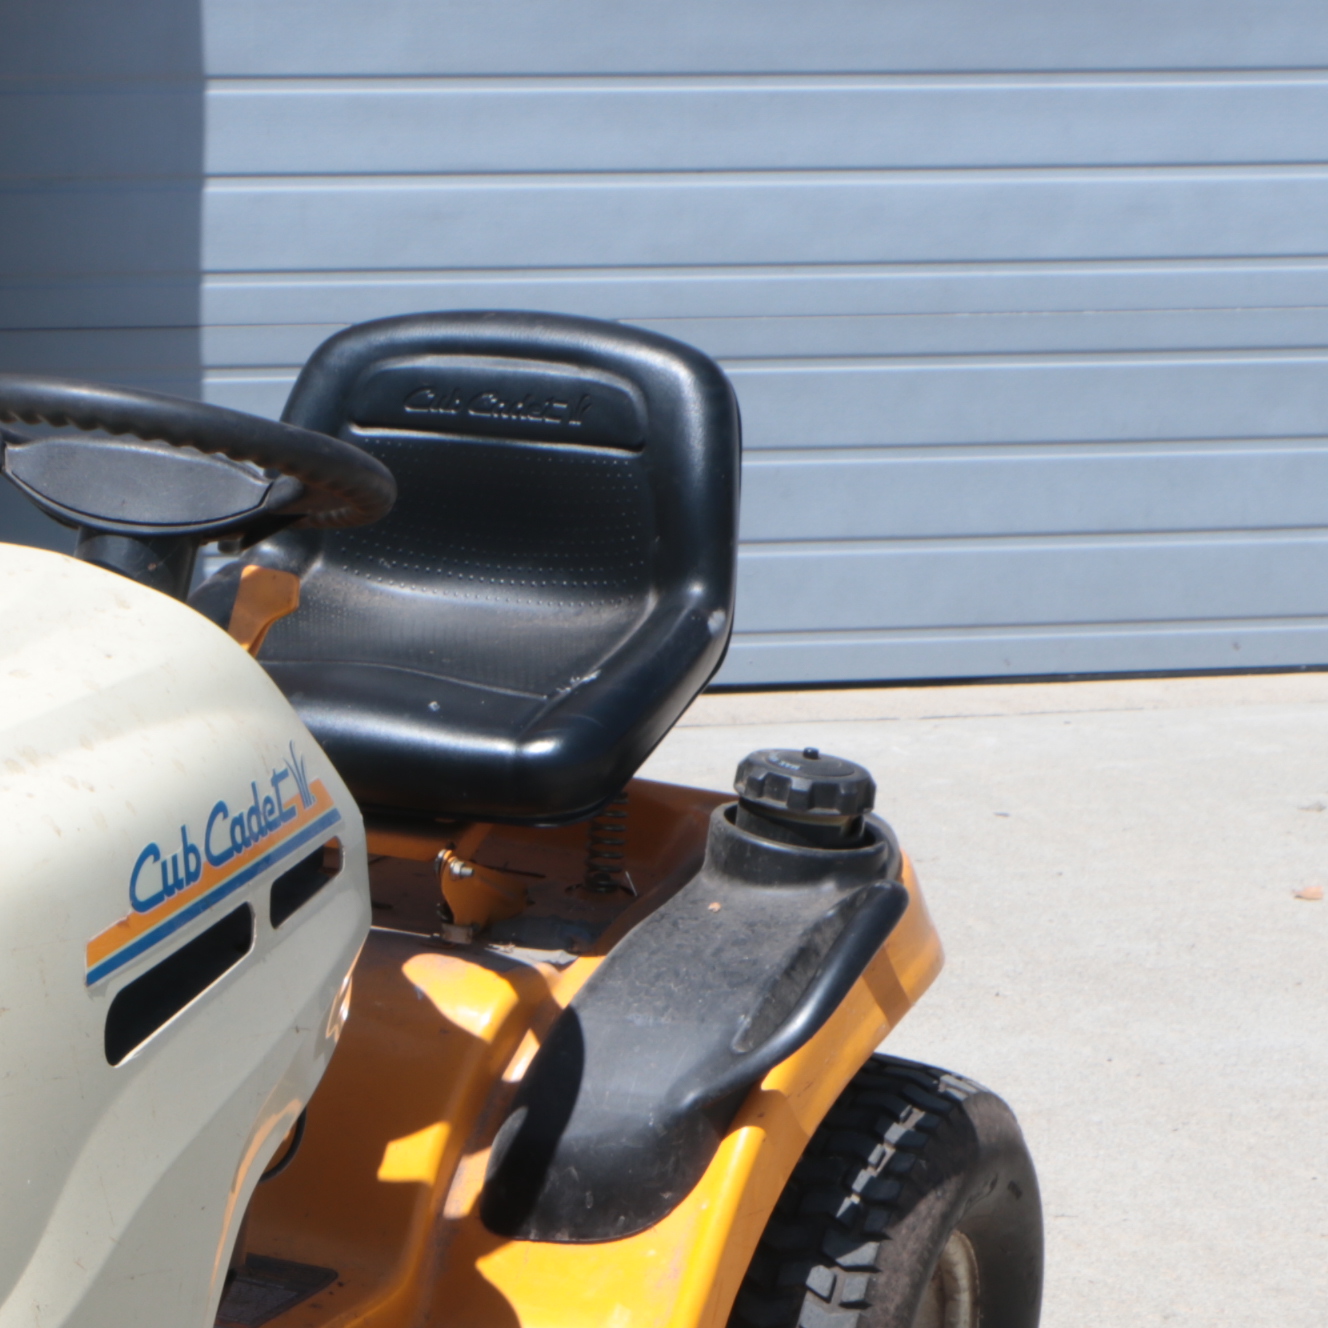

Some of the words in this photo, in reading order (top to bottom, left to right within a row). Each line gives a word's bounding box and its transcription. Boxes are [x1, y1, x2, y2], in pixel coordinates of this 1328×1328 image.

[404, 384, 463, 413] Cub
[468, 389, 568, 423] Cadet
[128, 824, 202, 914] Cub
[205, 768, 297, 868] Cadet
